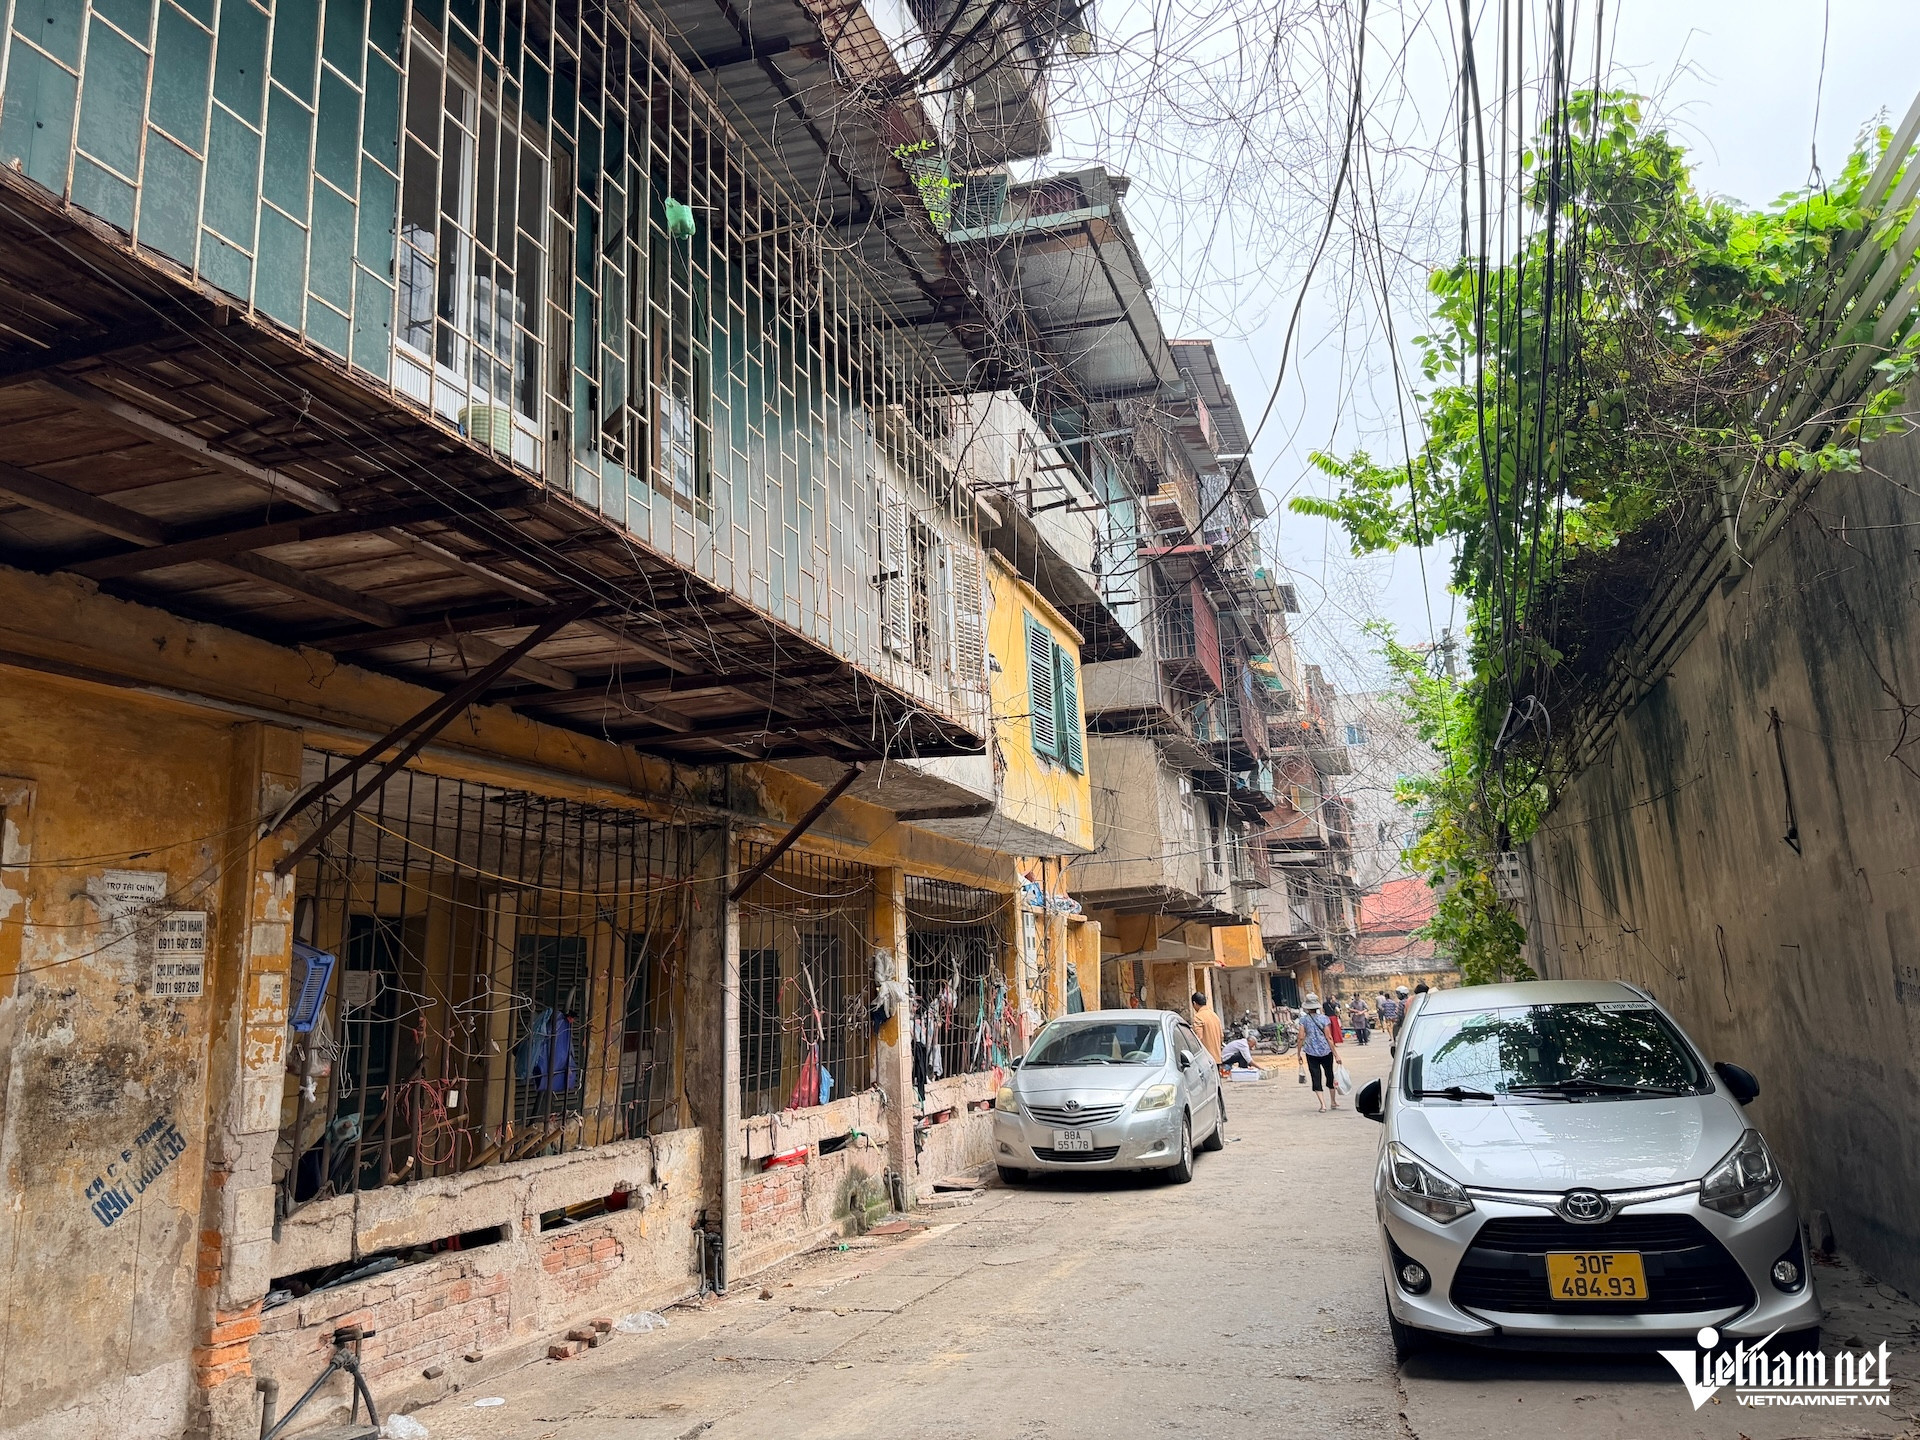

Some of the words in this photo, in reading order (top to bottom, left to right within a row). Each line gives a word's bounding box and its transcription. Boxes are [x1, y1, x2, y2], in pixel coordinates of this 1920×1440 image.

[158, 938, 174, 949] 0911
[177, 938, 189, 949] 987
[190, 938, 202, 949] 268
[156, 982, 172, 994] 0911
[174, 982, 186, 993] 987
[187, 981, 200, 993] 268
[1064, 1131, 1081, 1140] 88A
[1058, 1141, 1089, 1150] 551.78
[1573, 1255, 1614, 1275] 30F
[1562, 1277, 1636, 1297] 484.93
